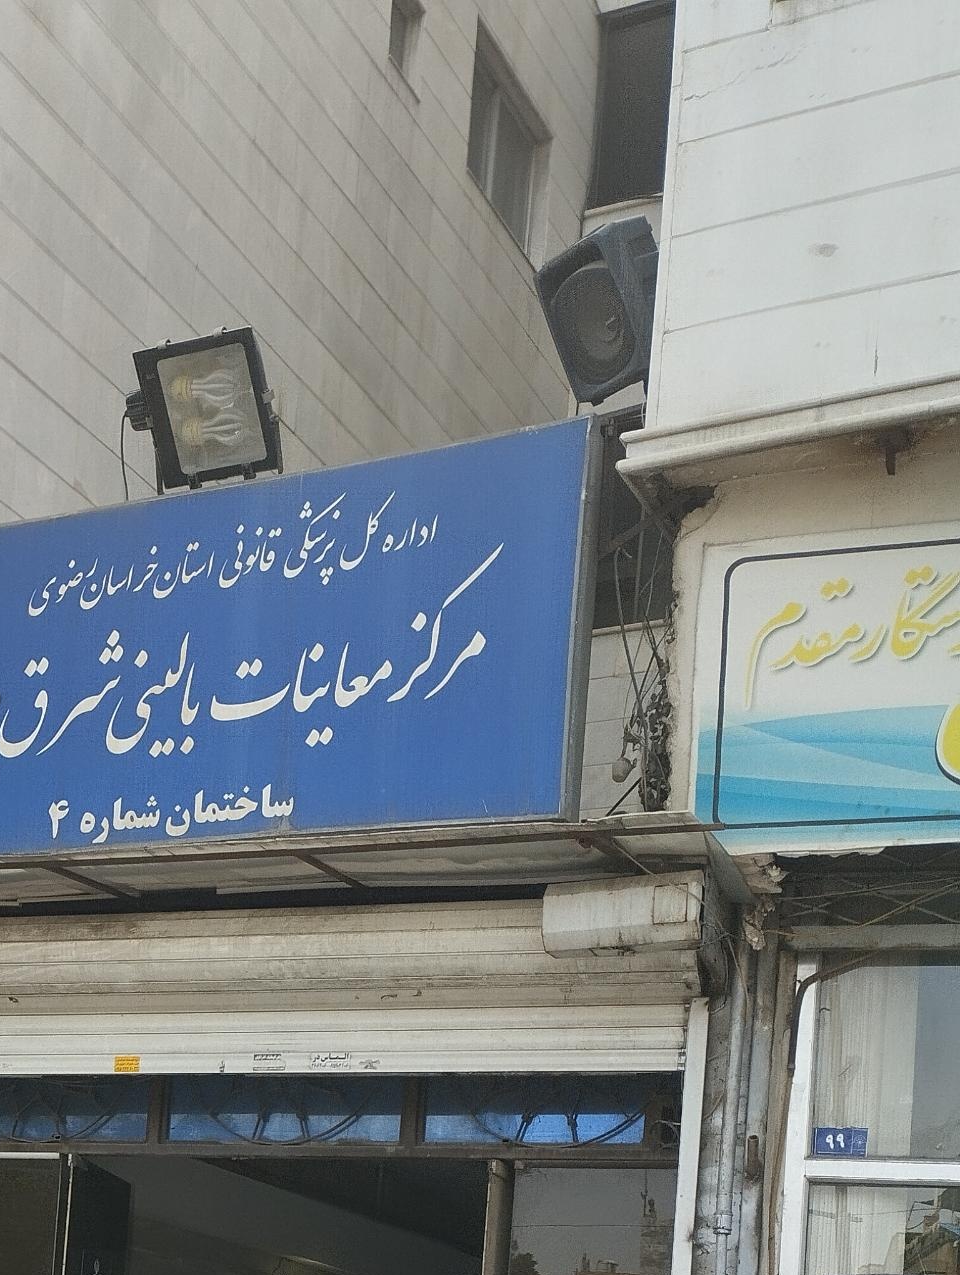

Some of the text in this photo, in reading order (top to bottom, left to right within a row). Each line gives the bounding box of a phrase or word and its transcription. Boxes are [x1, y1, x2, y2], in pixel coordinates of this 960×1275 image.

[28, 490, 439, 617] اداره کل پزشکی قانونی استان خراسان رضوی
[387, 542, 505, 703] مرکز
[744, 577, 865, 712] مقدم
[105, 631, 200, 758] بالینی
[210, 642, 393, 748] معاینات
[48, 783, 295, 844] ساختمان شماره ۴
[825, 1133, 845, 1150] ۹۹
